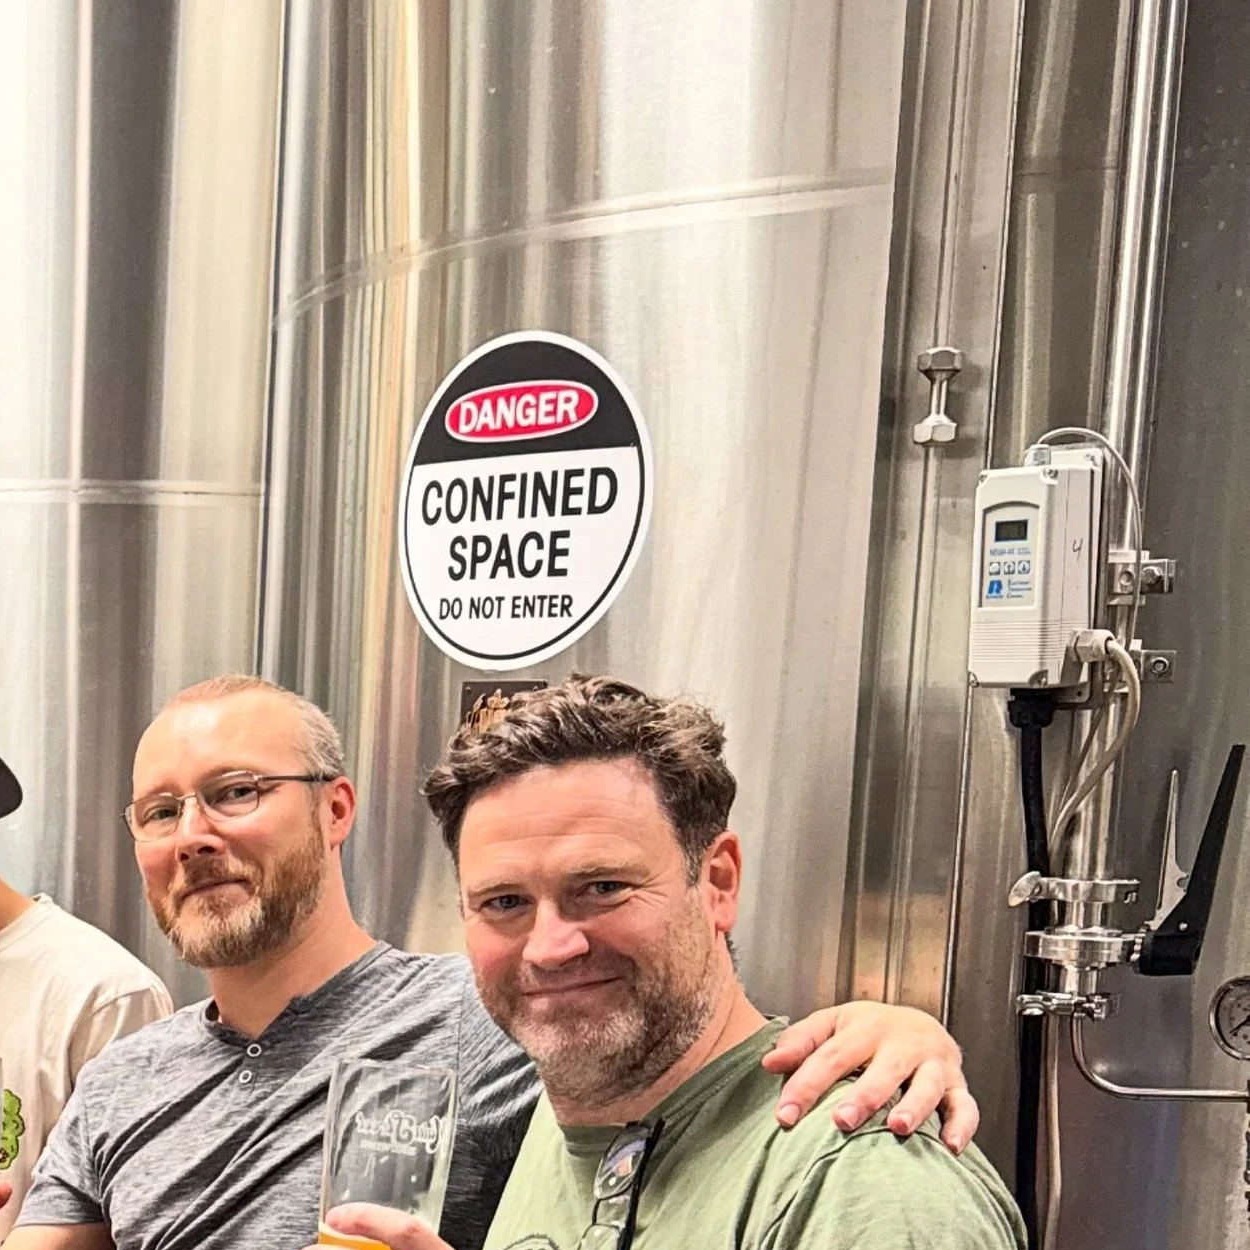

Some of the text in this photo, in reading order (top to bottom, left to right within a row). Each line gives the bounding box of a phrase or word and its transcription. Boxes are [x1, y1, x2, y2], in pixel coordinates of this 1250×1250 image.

[458, 388, 580, 434] DANGER
[421, 466, 618, 526] CONFINED
[447, 529, 571, 582] SPACE
[439, 594, 574, 620] DO NOT ENTER
